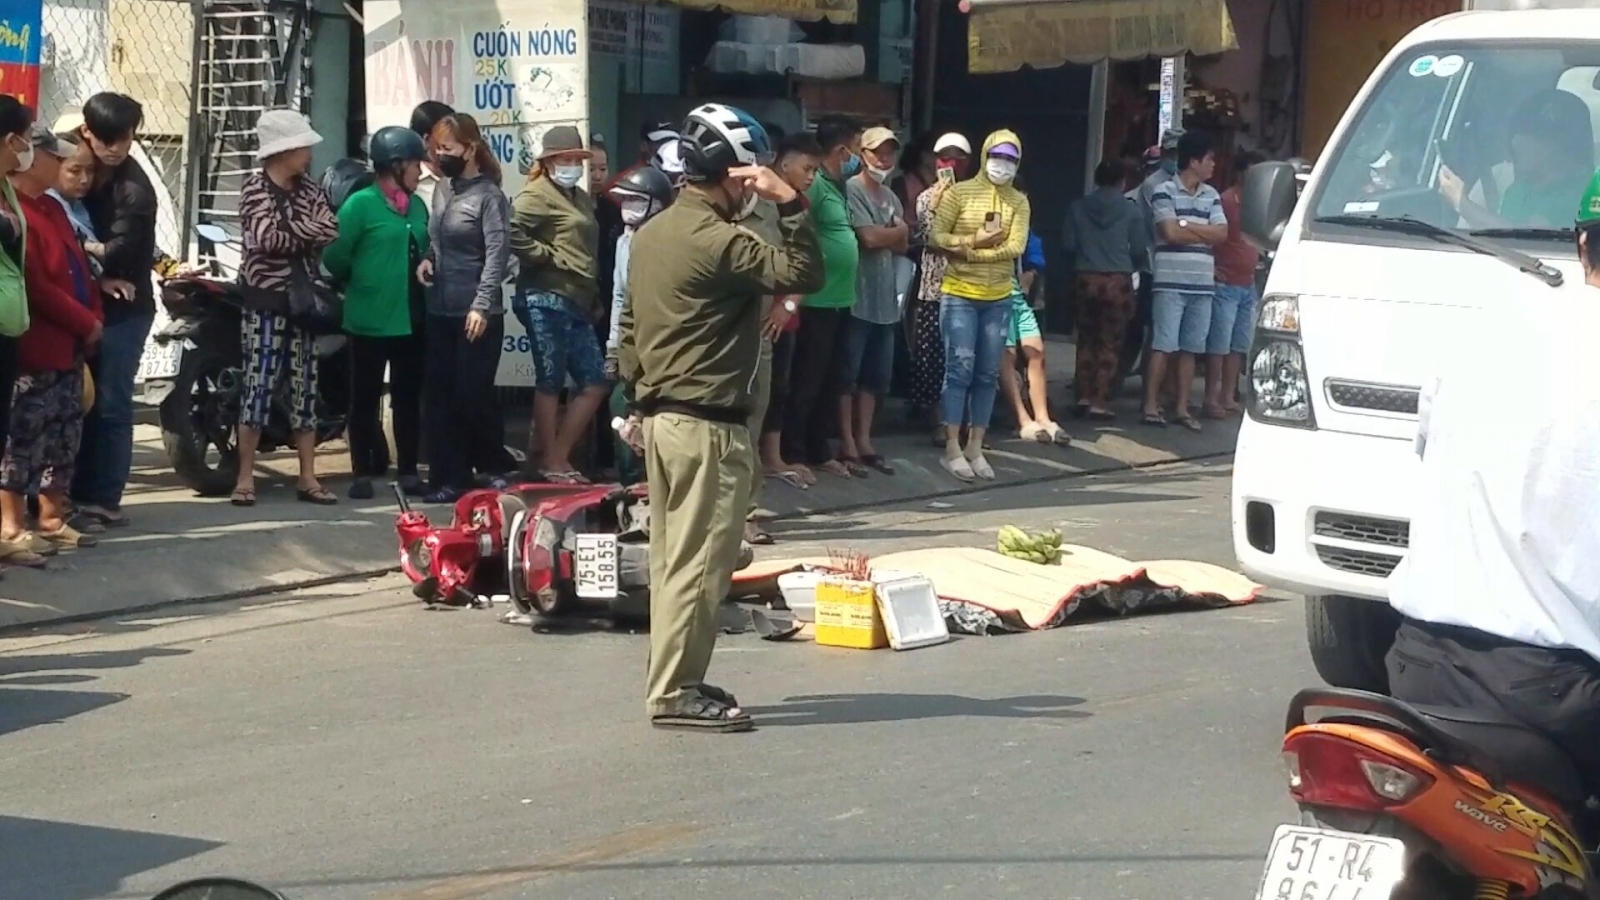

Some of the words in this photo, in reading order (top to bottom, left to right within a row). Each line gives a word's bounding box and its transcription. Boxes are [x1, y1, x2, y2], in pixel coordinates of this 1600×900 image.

[474, 21, 521, 57] CUỐN
[528, 22, 577, 56] NÓNG
[475, 59, 507, 76] 25K
[475, 76, 516, 110] ƯỚT
[490, 110, 521, 126] 20K
[597, 539, 615, 592] 158.55
[1286, 835, 1377, 882] 51-R4
